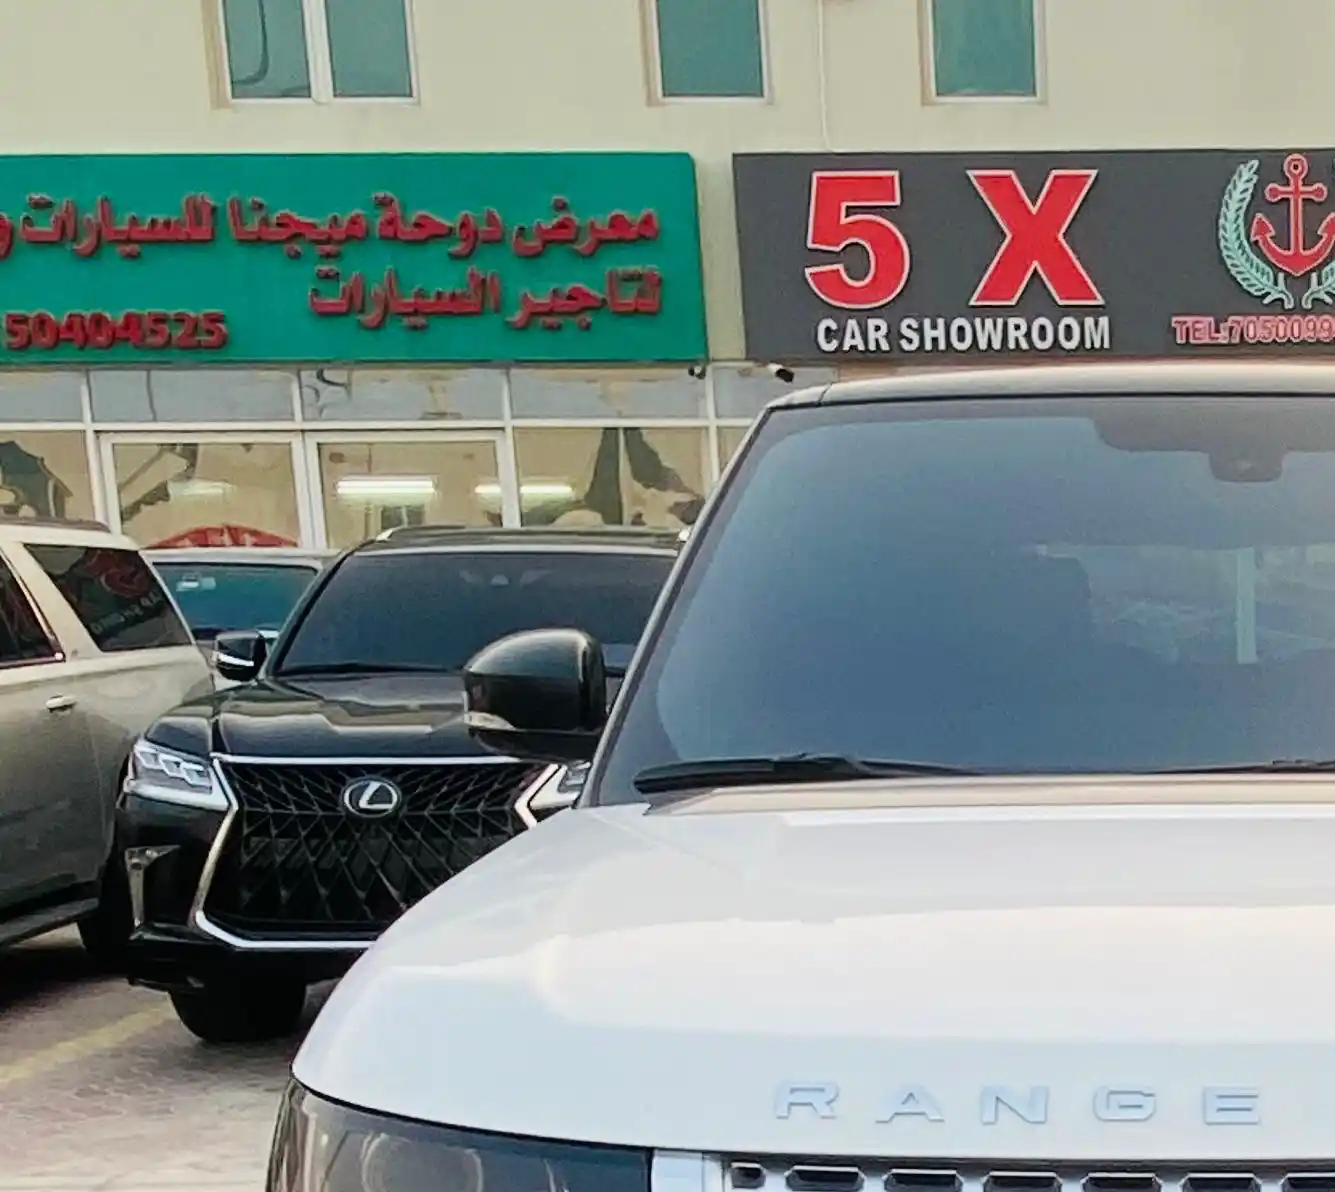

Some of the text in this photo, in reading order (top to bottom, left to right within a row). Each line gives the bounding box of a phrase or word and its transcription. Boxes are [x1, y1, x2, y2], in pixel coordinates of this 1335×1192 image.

[20, 192, 215, 260] للسيارات
[372, 191, 504, 257] دوحة
[512, 194, 659, 257] معرض
[803, 168, 1106, 309] 5 X
[309, 265, 501, 331] السيارات
[816, 315, 1111, 352] CAR SHOWROOM
[774, 1079, 1262, 1126] RANGE
